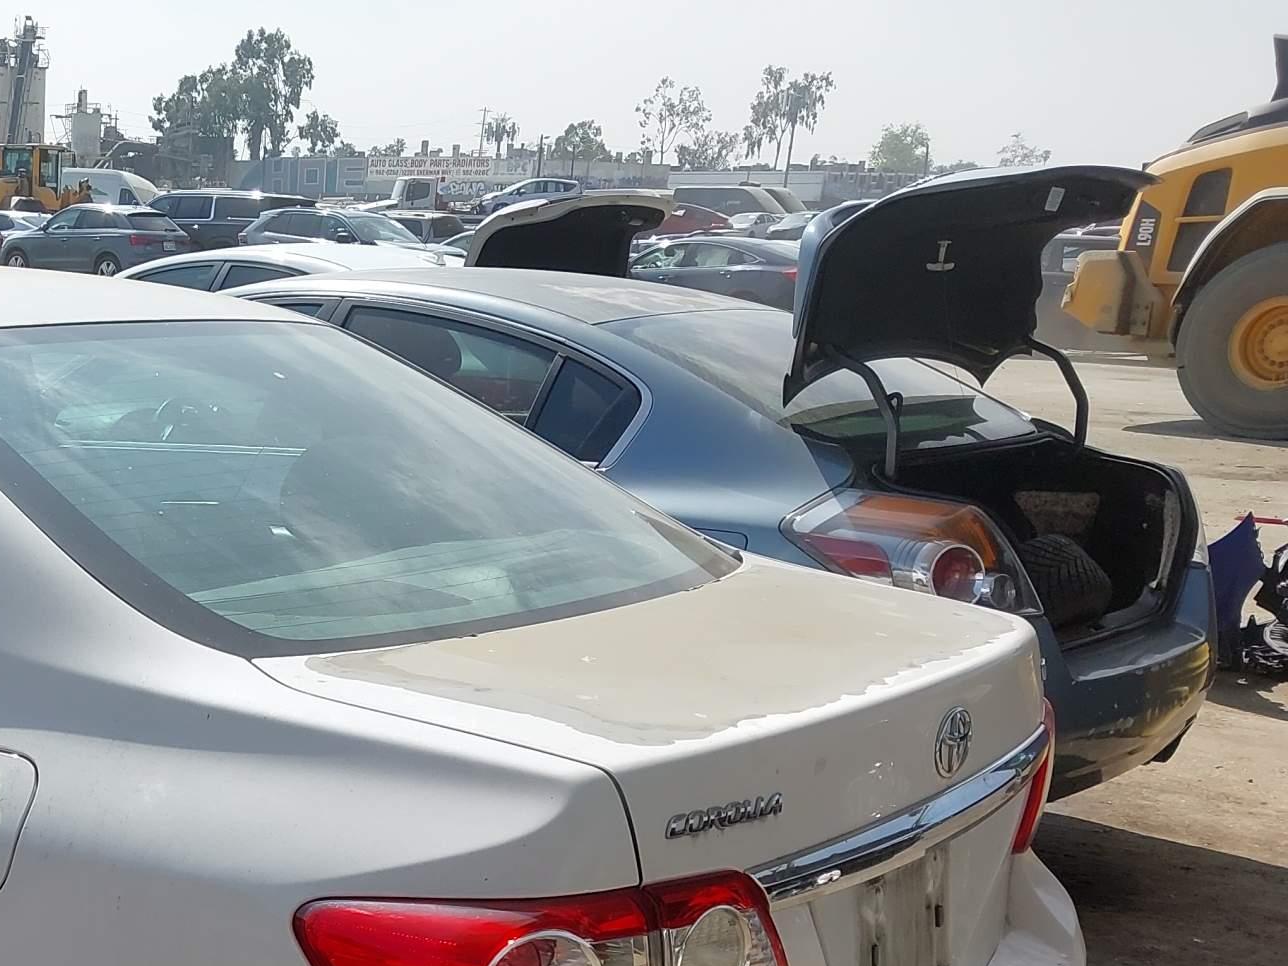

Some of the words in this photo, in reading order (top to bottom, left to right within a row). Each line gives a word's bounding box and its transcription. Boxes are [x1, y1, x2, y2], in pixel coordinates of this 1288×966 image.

[370, 159, 386, 168] AUTO
[1136, 219, 1156, 246] L90H
[665, 792, 783, 839] COROLLA
